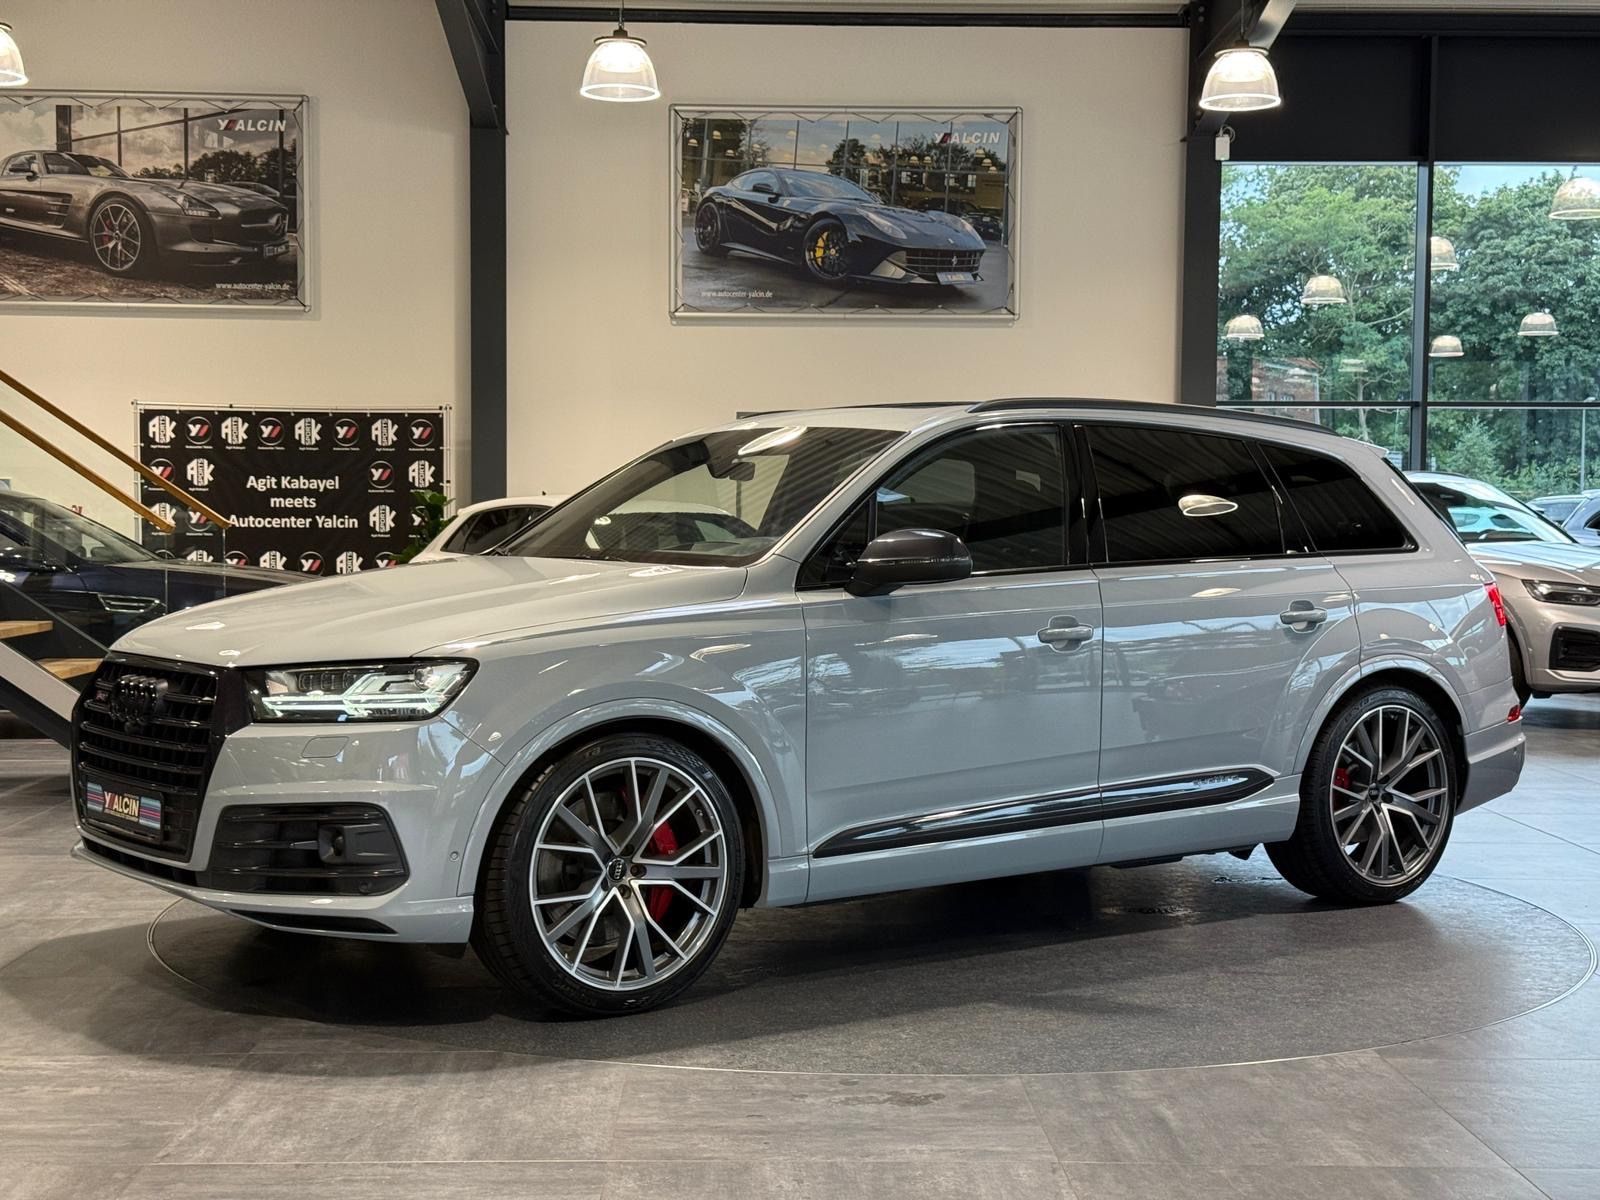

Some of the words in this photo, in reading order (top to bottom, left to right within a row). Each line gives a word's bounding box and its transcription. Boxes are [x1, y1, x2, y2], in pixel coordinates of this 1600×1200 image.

[246, 475, 277, 492] Agit
[281, 475, 340, 493] Kabayel
[270, 495, 317, 508] meets
[229, 514, 313, 528] Autocenter
[315, 514, 359, 529] Yalcin
